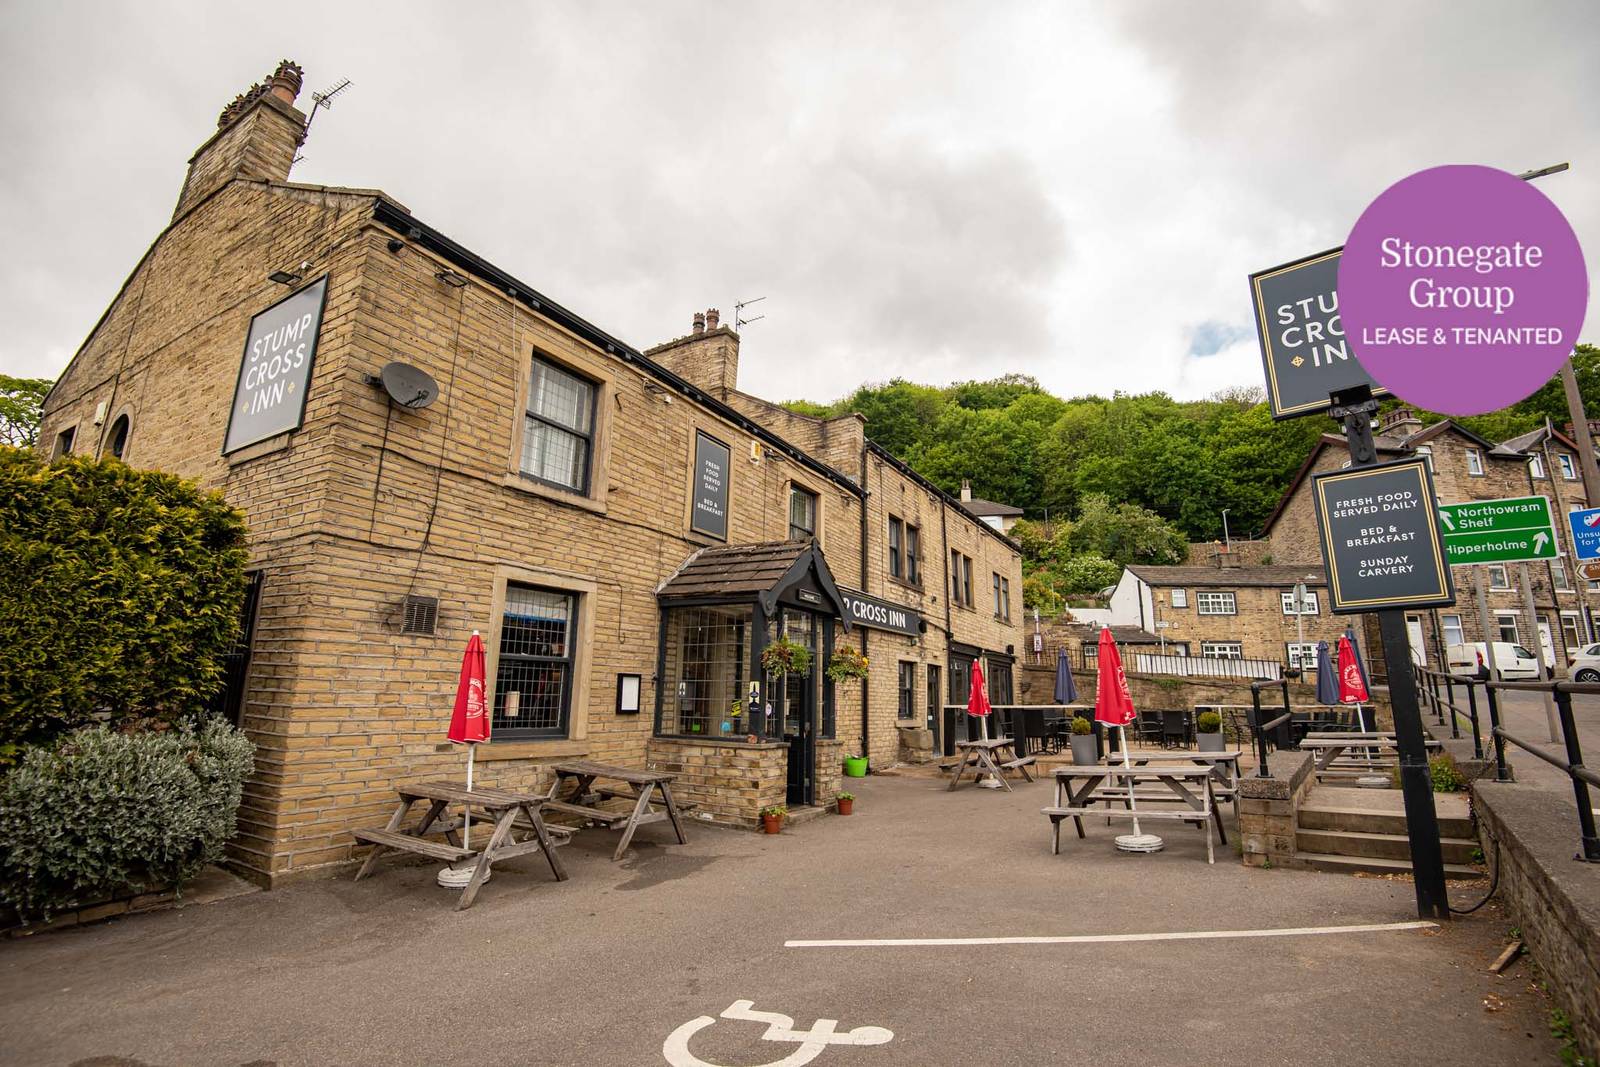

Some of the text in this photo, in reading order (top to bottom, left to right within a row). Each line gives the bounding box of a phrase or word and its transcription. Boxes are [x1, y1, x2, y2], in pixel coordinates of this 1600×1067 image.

[1277, 290, 1339, 325] STU
[250, 313, 312, 363] STUMP
[1312, 339, 1350, 367] IN
[245, 342, 306, 390] CROSS
[251, 379, 286, 415] INN
[703, 475, 721, 486] SERVED
[705, 468, 719, 478] FOOD
[704, 483, 718, 493] DAILY
[1336, 491, 1412, 509] FRESH FOOD
[697, 502, 723, 517] BREAKFAST
[1333, 500, 1418, 518] SERVED DAILY
[1457, 503, 1541, 518] Northowram
[1460, 517, 1494, 529] Shelf
[1360, 525, 1397, 537] BED &
[1577, 530, 1600, 539] Unsu
[1346, 532, 1416, 548] BREAKFAST
[1581, 538, 1595, 546] for
[1360, 555, 1409, 568] SUNDAY
[1358, 565, 1414, 578] CARVERY
[852, 600, 887, 624] CROSS
[889, 610, 906, 628] INN
